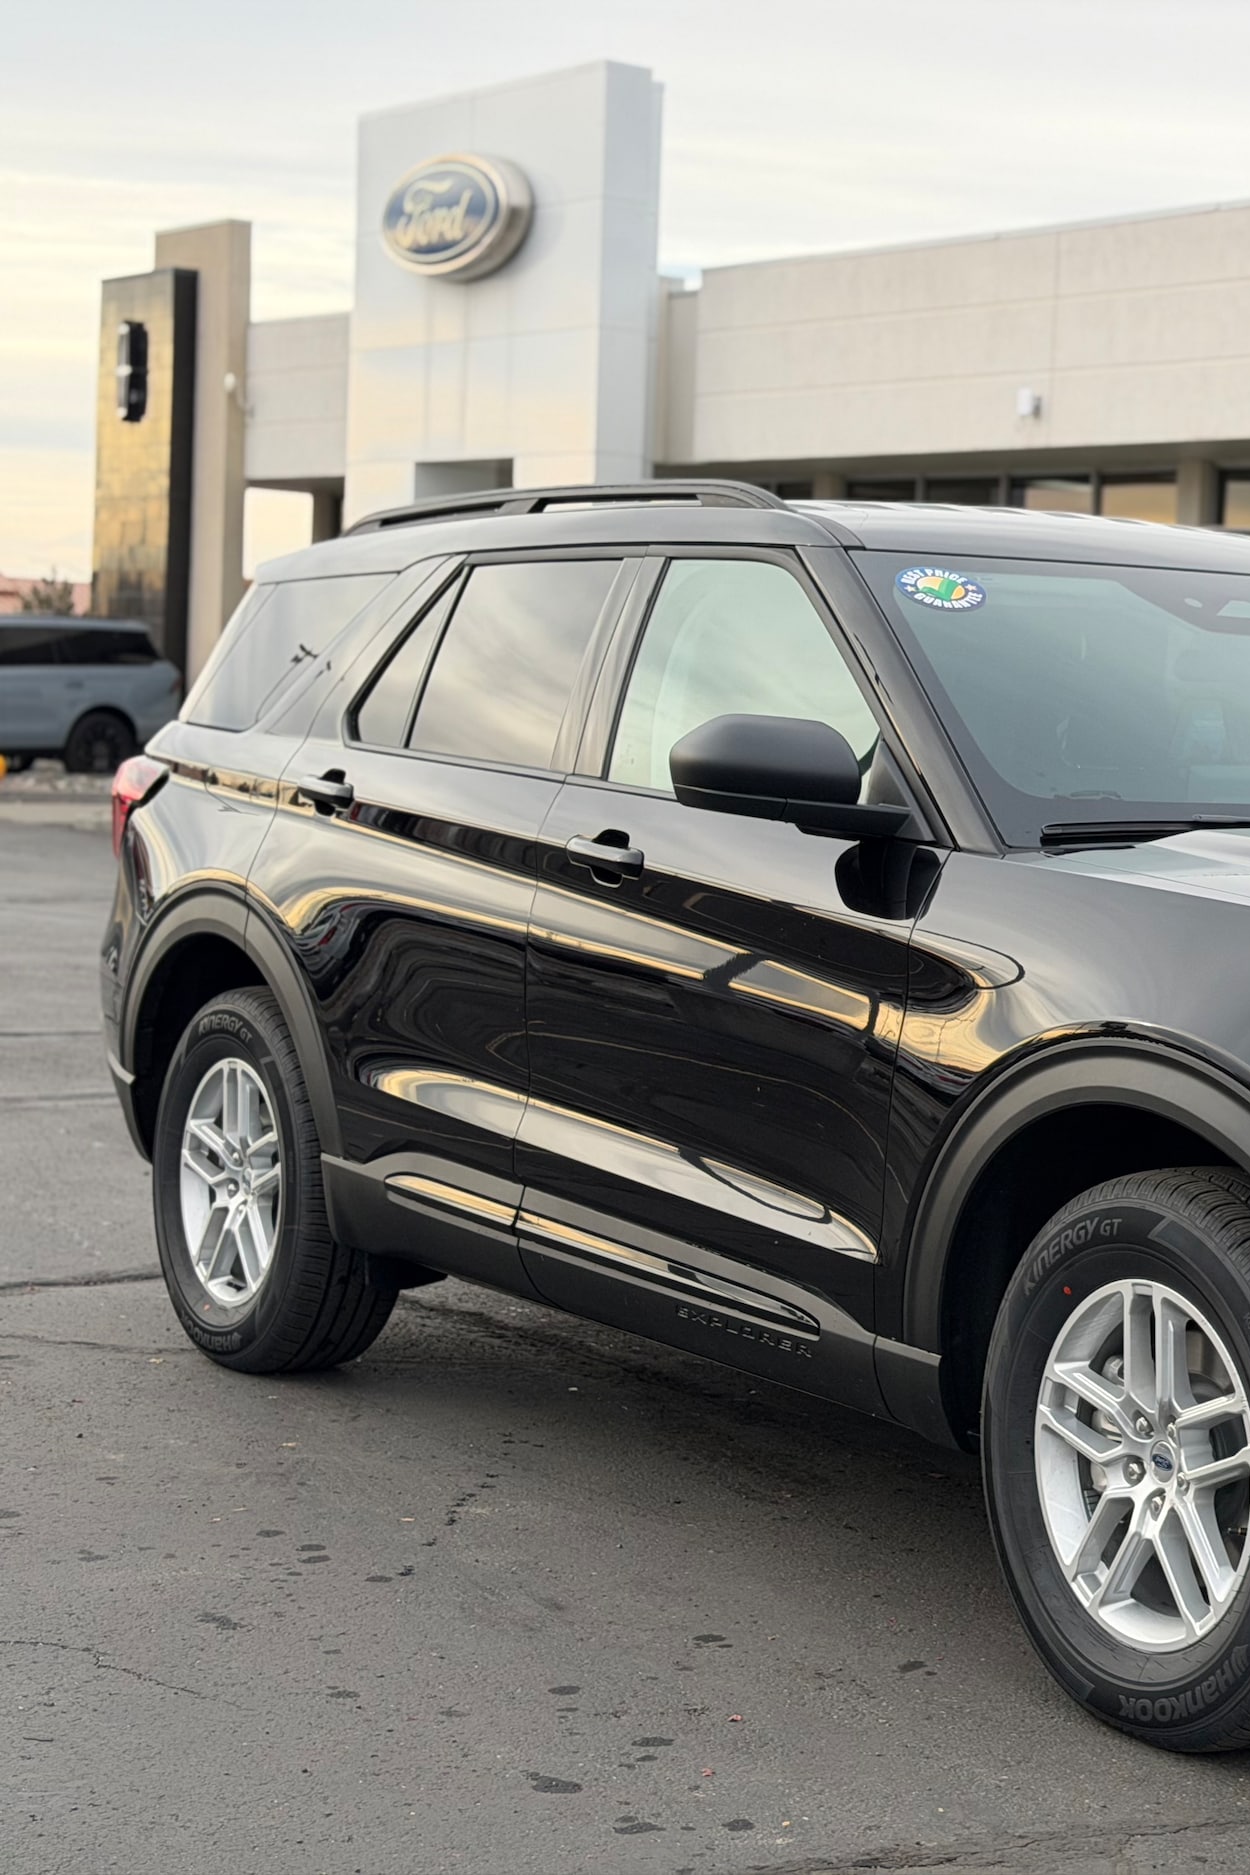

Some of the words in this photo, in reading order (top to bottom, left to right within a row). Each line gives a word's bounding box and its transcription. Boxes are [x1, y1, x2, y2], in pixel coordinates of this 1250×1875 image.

[394, 178, 473, 248] Ford
[925, 568, 968, 584] PRICE
[1100, 1218, 1123, 1237] GT
[676, 1304, 812, 1358] EXPLORER
